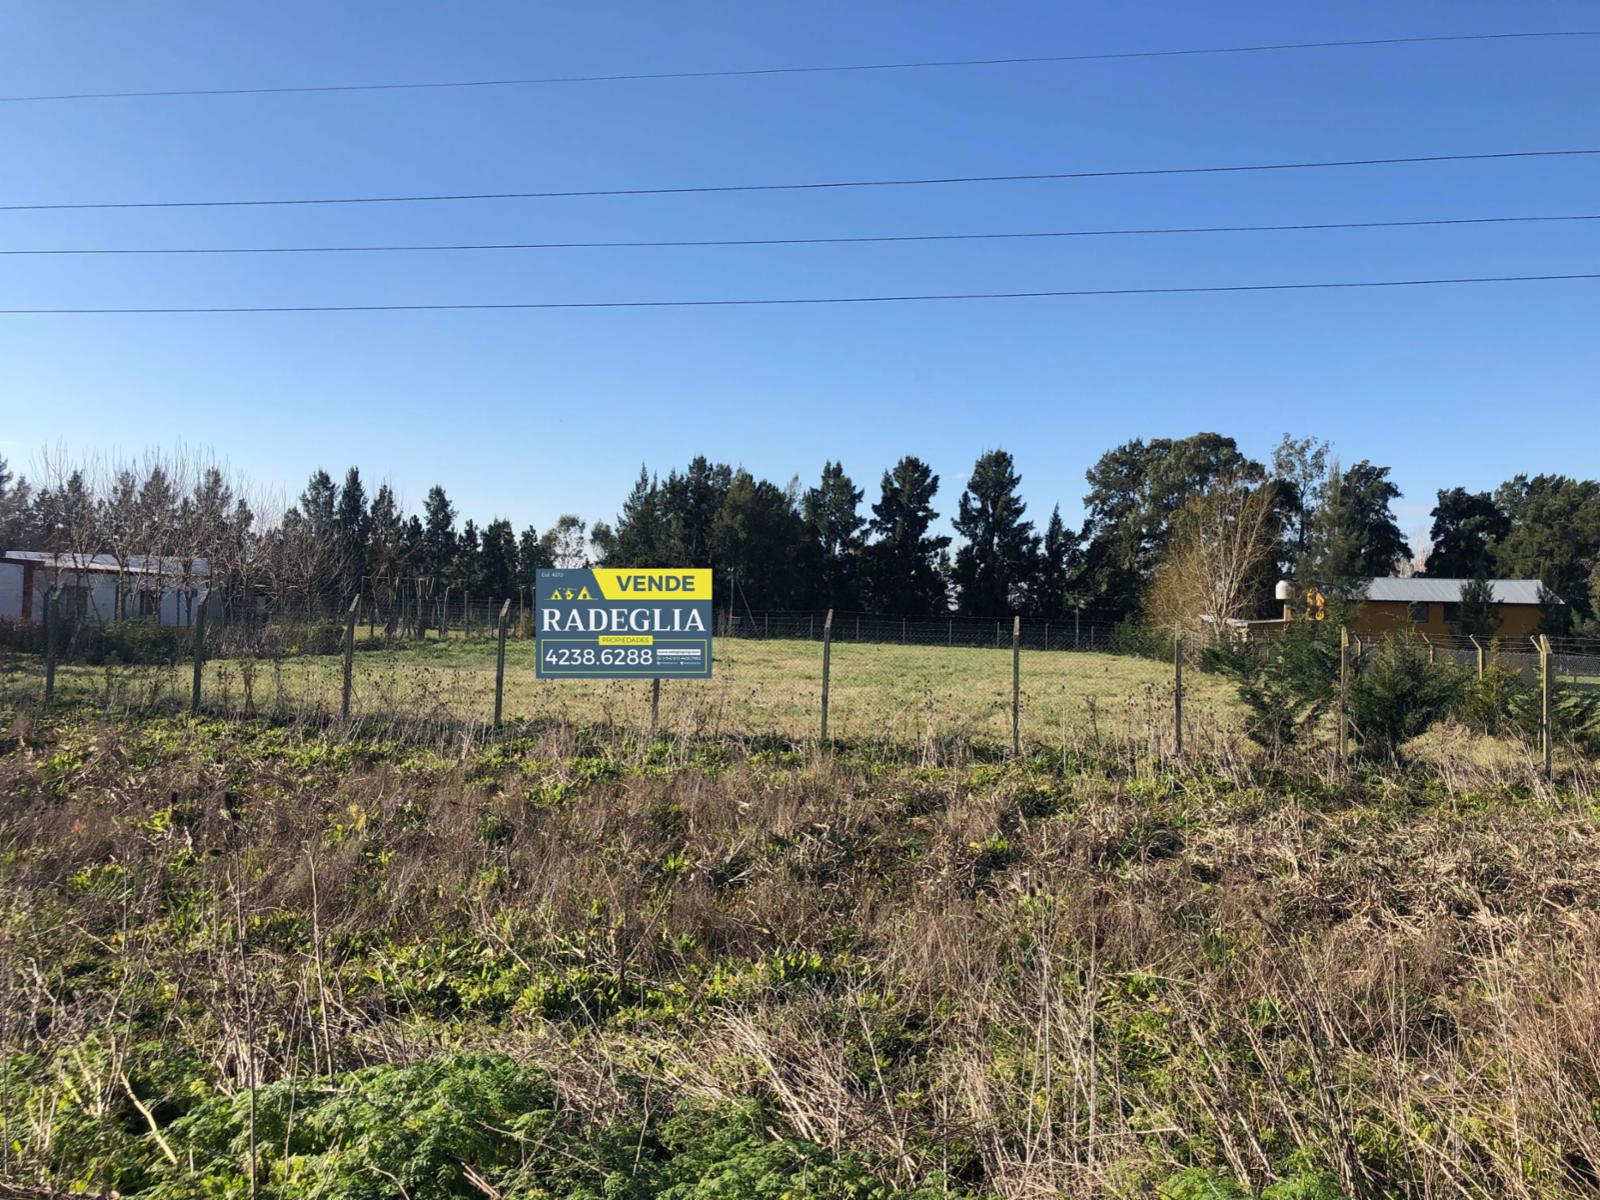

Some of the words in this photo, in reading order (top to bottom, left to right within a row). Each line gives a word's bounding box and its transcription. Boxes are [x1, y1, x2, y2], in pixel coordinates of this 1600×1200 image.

[616, 575, 695, 592] VENDE
[541, 608, 706, 632] RADEGLIA
[601, 636, 650, 644] PROPIEDADES
[545, 649, 653, 665] 4238.6288
